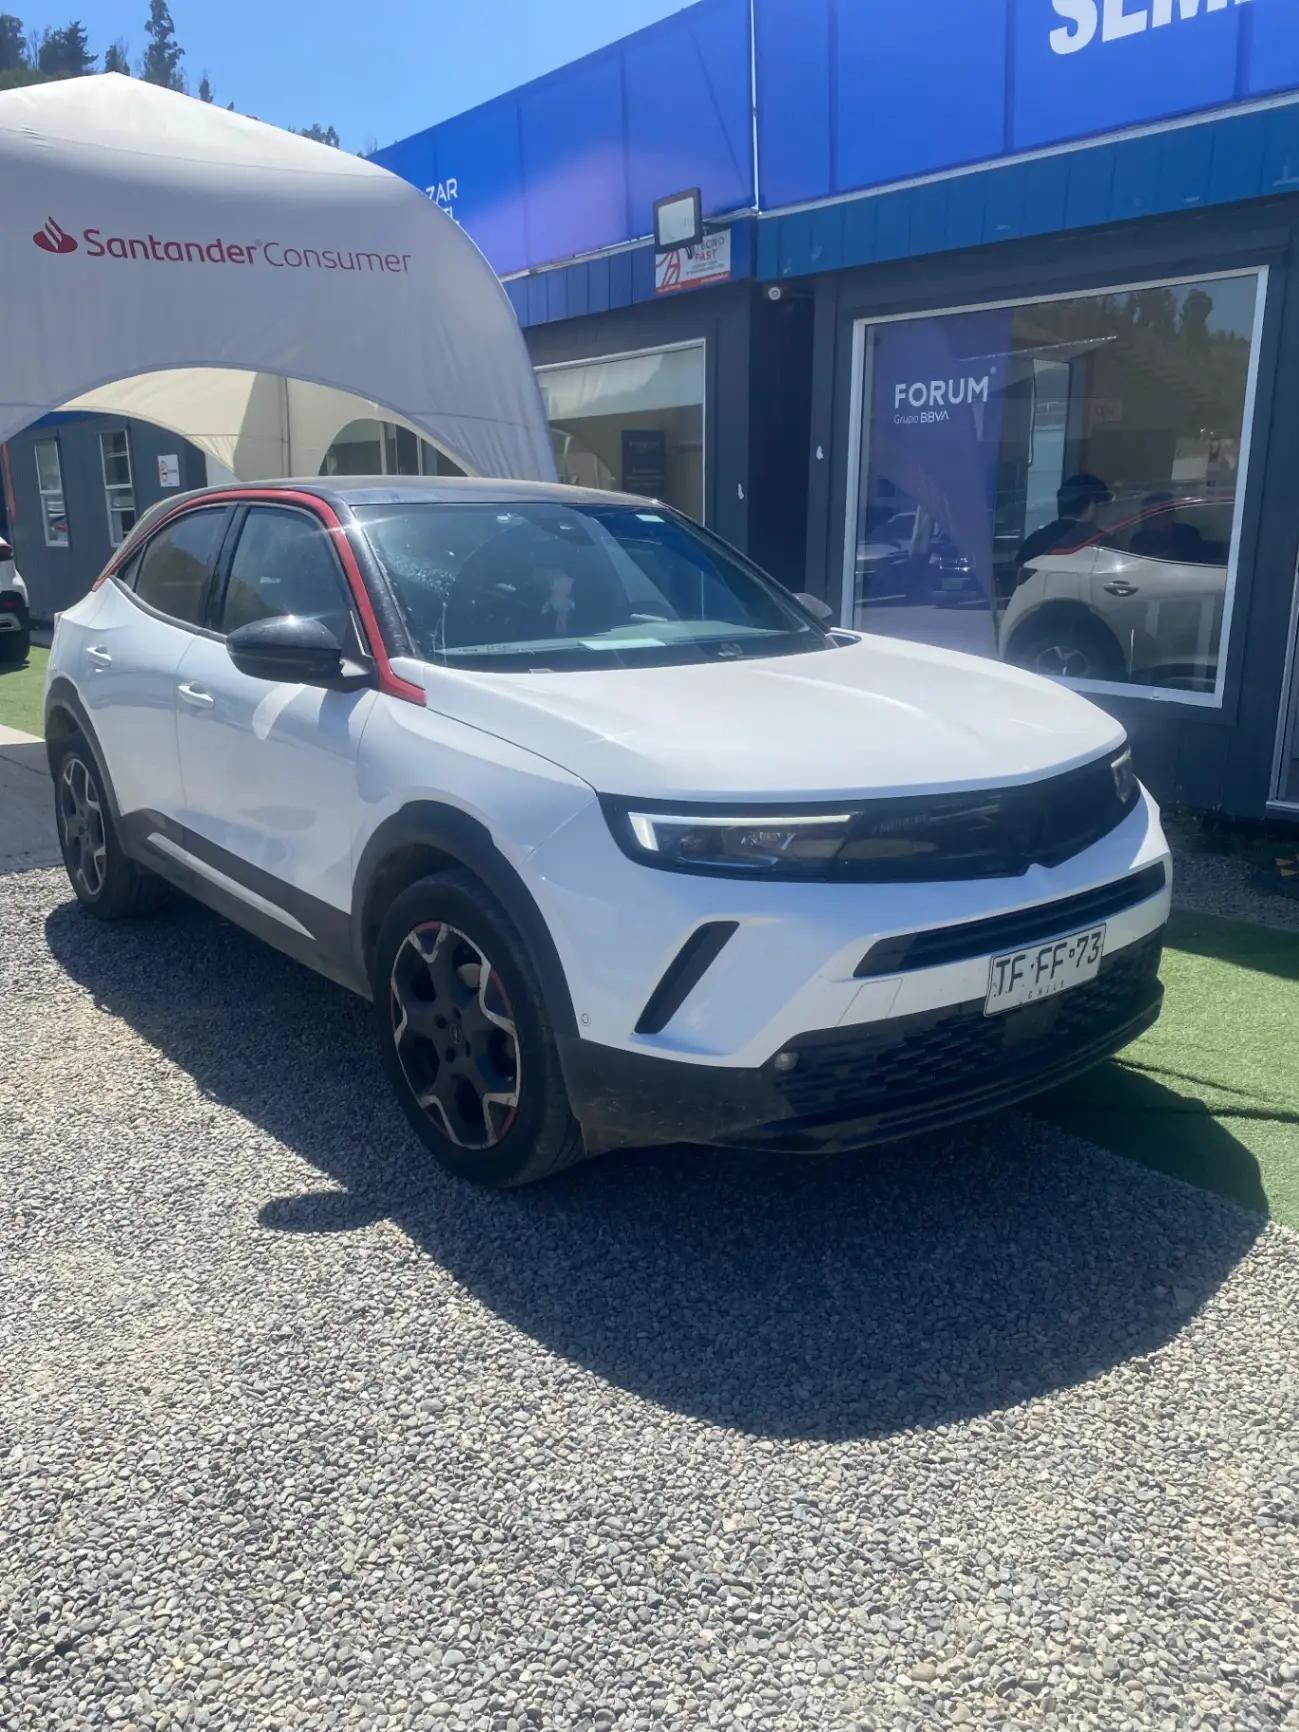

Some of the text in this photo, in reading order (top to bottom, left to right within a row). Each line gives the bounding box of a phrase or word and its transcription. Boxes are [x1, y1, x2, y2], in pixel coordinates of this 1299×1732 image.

[83, 228, 412, 273] Santander Consumer
[894, 375, 990, 409] FORUM
[894, 410, 950, 425] Grupo BBVA
[1027, 980, 1065, 1000] CHILE
